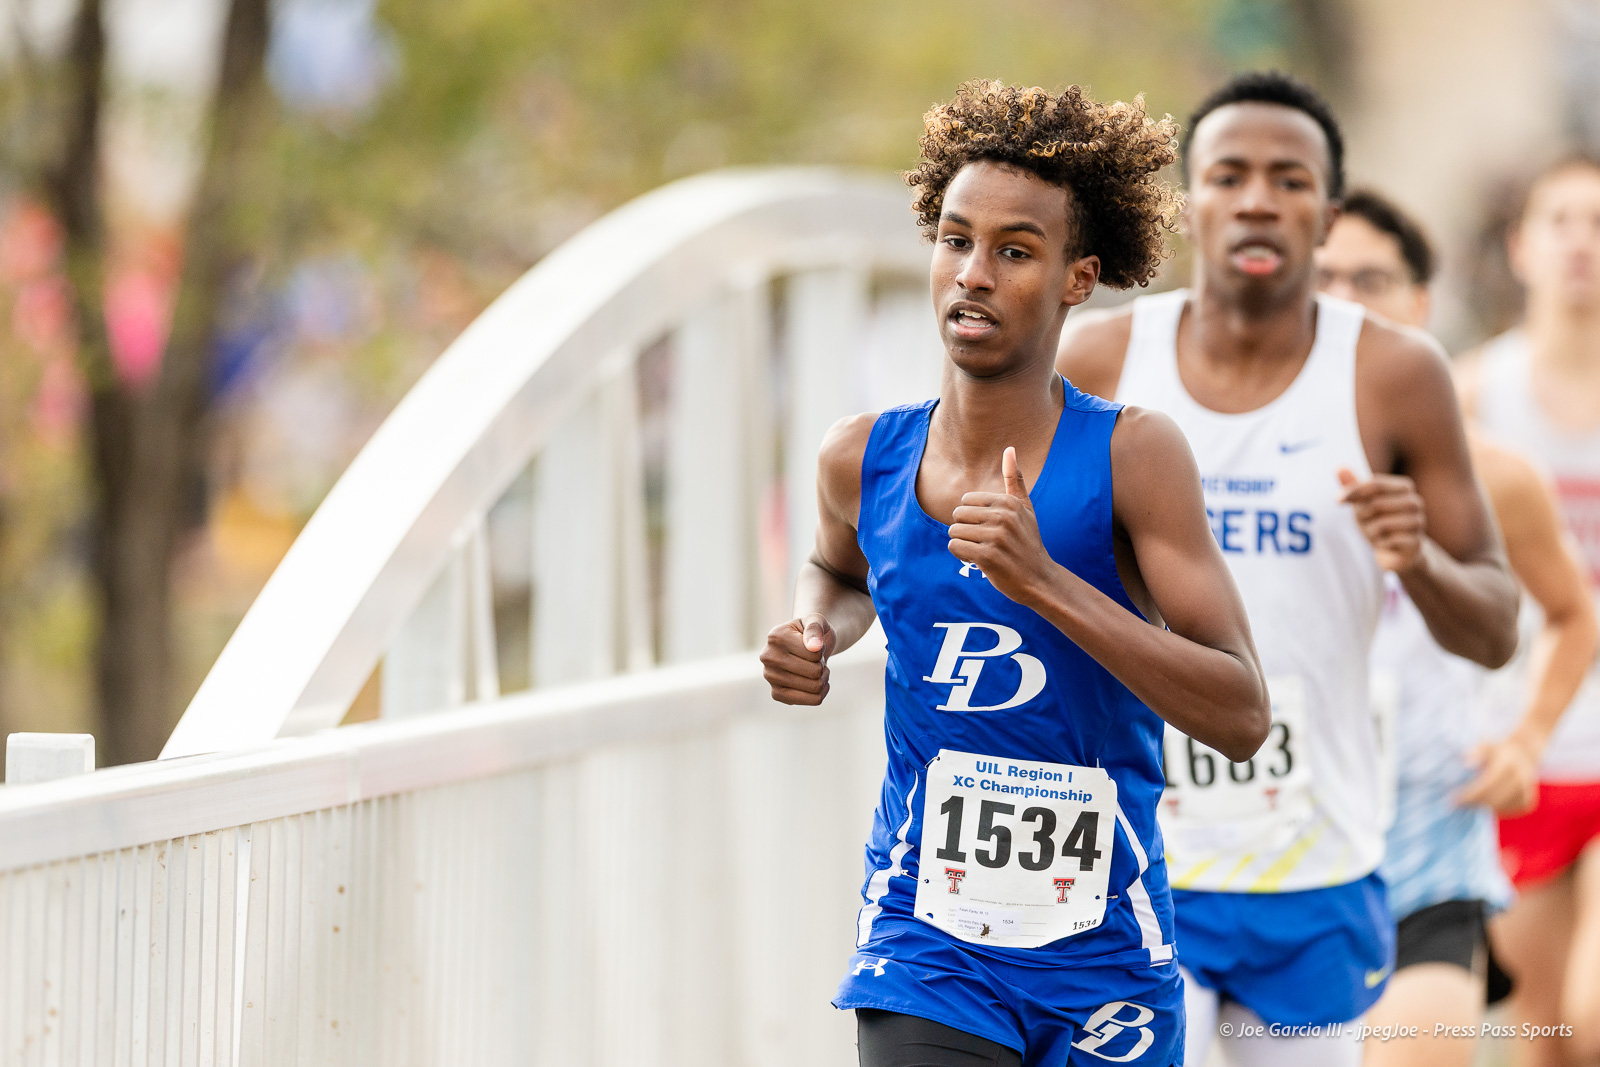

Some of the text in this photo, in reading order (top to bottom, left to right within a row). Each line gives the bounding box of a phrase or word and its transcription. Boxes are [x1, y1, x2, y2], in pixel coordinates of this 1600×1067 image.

[976, 760, 1002, 776] UIL
[1007, 765, 1063, 783] Region
[952, 775, 1093, 804] XC Championship
[936, 795, 1102, 872] 1534
[1072, 919, 1098, 931] 1534
